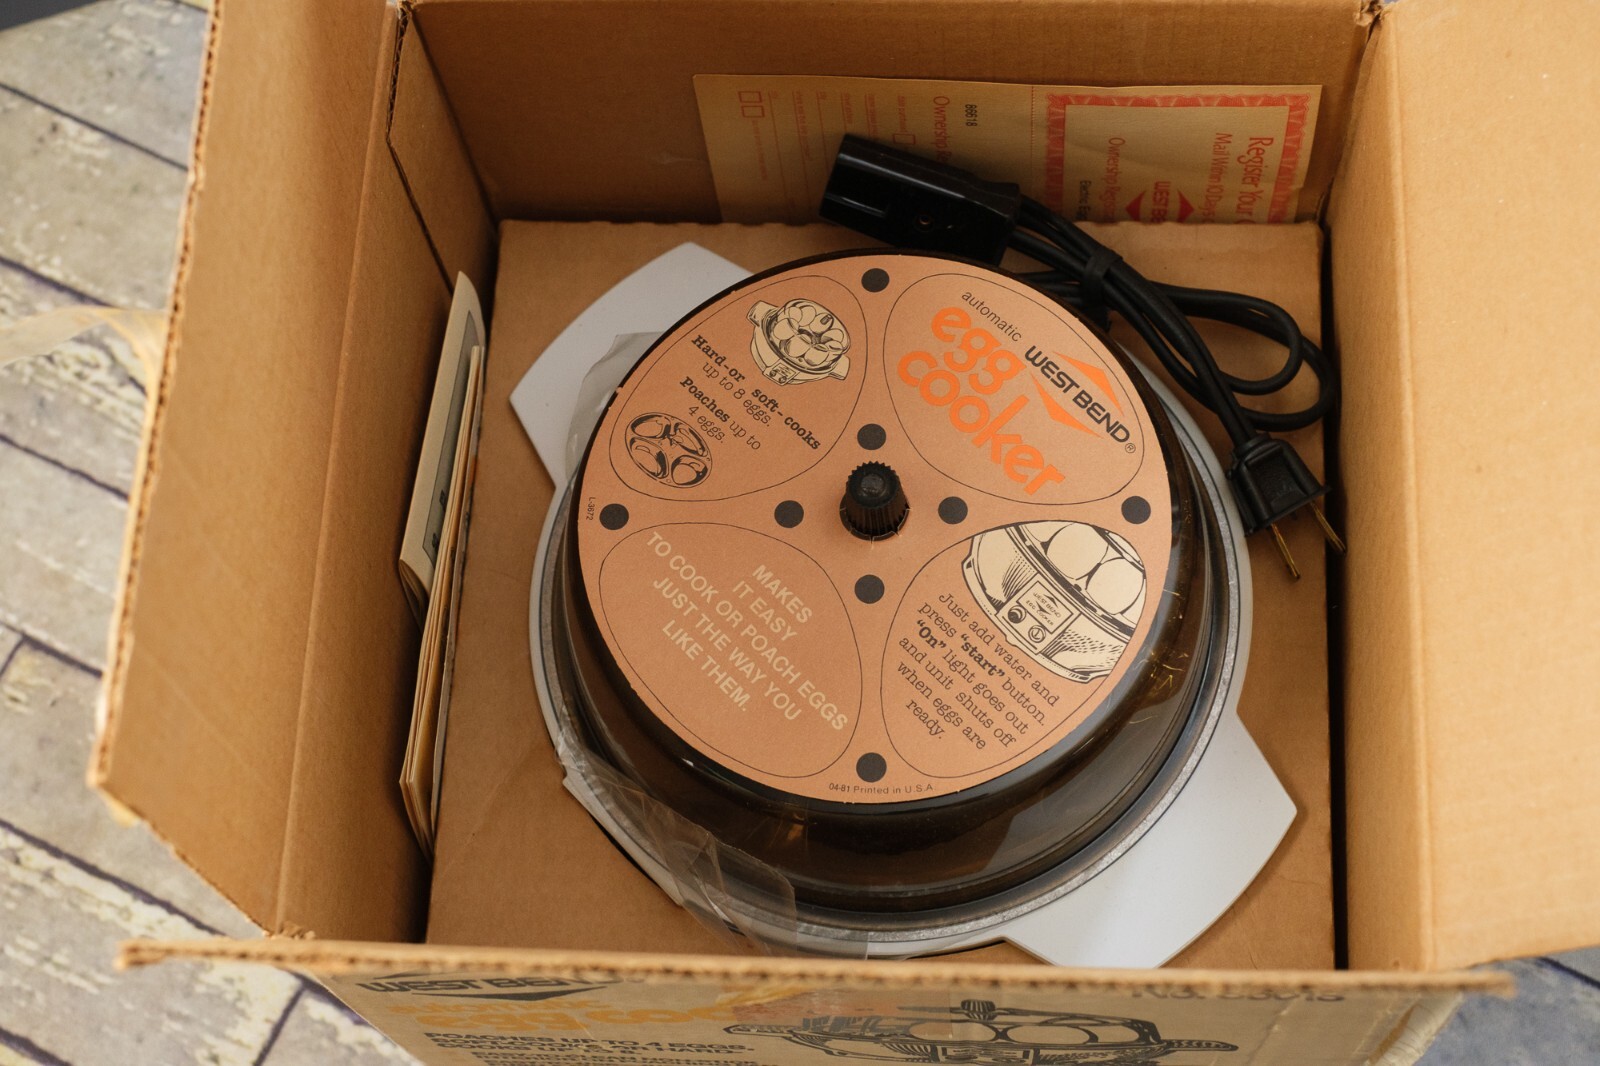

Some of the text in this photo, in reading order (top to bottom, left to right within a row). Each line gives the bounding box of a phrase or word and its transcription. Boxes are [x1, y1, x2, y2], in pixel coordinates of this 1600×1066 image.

[931, 96, 950, 150] Ownership
[964, 104, 978, 127] 86618
[1101, 138, 1125, 184] Ownership
[1212, 133, 1233, 155] Mail
[1237, 137, 1274, 188] Register
[1153, 181, 1172, 223] WEST BE
[1236, 190, 1264, 216] Your
[962, 291, 1022, 342] automatic
[931, 307, 1027, 395] egg
[1024, 345, 1079, 393] WEST
[680, 376, 761, 450] Poaches up to
[702, 362, 771, 427] up to 8 eggs.
[688, 405, 725, 443] 4 eggs.
[897, 351, 1066, 496] cooker
[732, 580, 797, 641] IT EASY
[752, 564, 812, 623] MAKES
[1025, 600, 1036, 609] EGG
[1033, 593, 1047, 605] WEST
[647, 531, 848, 730] TO COOK OR POACH EGGS
[653, 577, 802, 720] JUST THE WAY YOU
[939, 593, 1060, 707] Just add water and
[662, 619, 750, 712] LIKE THEM.
[917, 619, 1029, 734] “On” light goes out
[918, 602, 1045, 726] press “start” button.
[898, 662, 986, 750] when eggs are
[899, 637, 1017, 747] and unit shuts off
[906, 700, 945, 740] ready.
[853, 785, 888, 794] Printed
[893, 786, 901, 794] in
[356, 979, 483, 992] WEST
[388, 999, 610, 1012] automatic
[415, 1007, 740, 1031] egg coo
[424, 1032, 556, 1042] POACHES
[667, 1042, 755, 1051] EGGS.
[437, 1043, 532, 1051] COOKS
